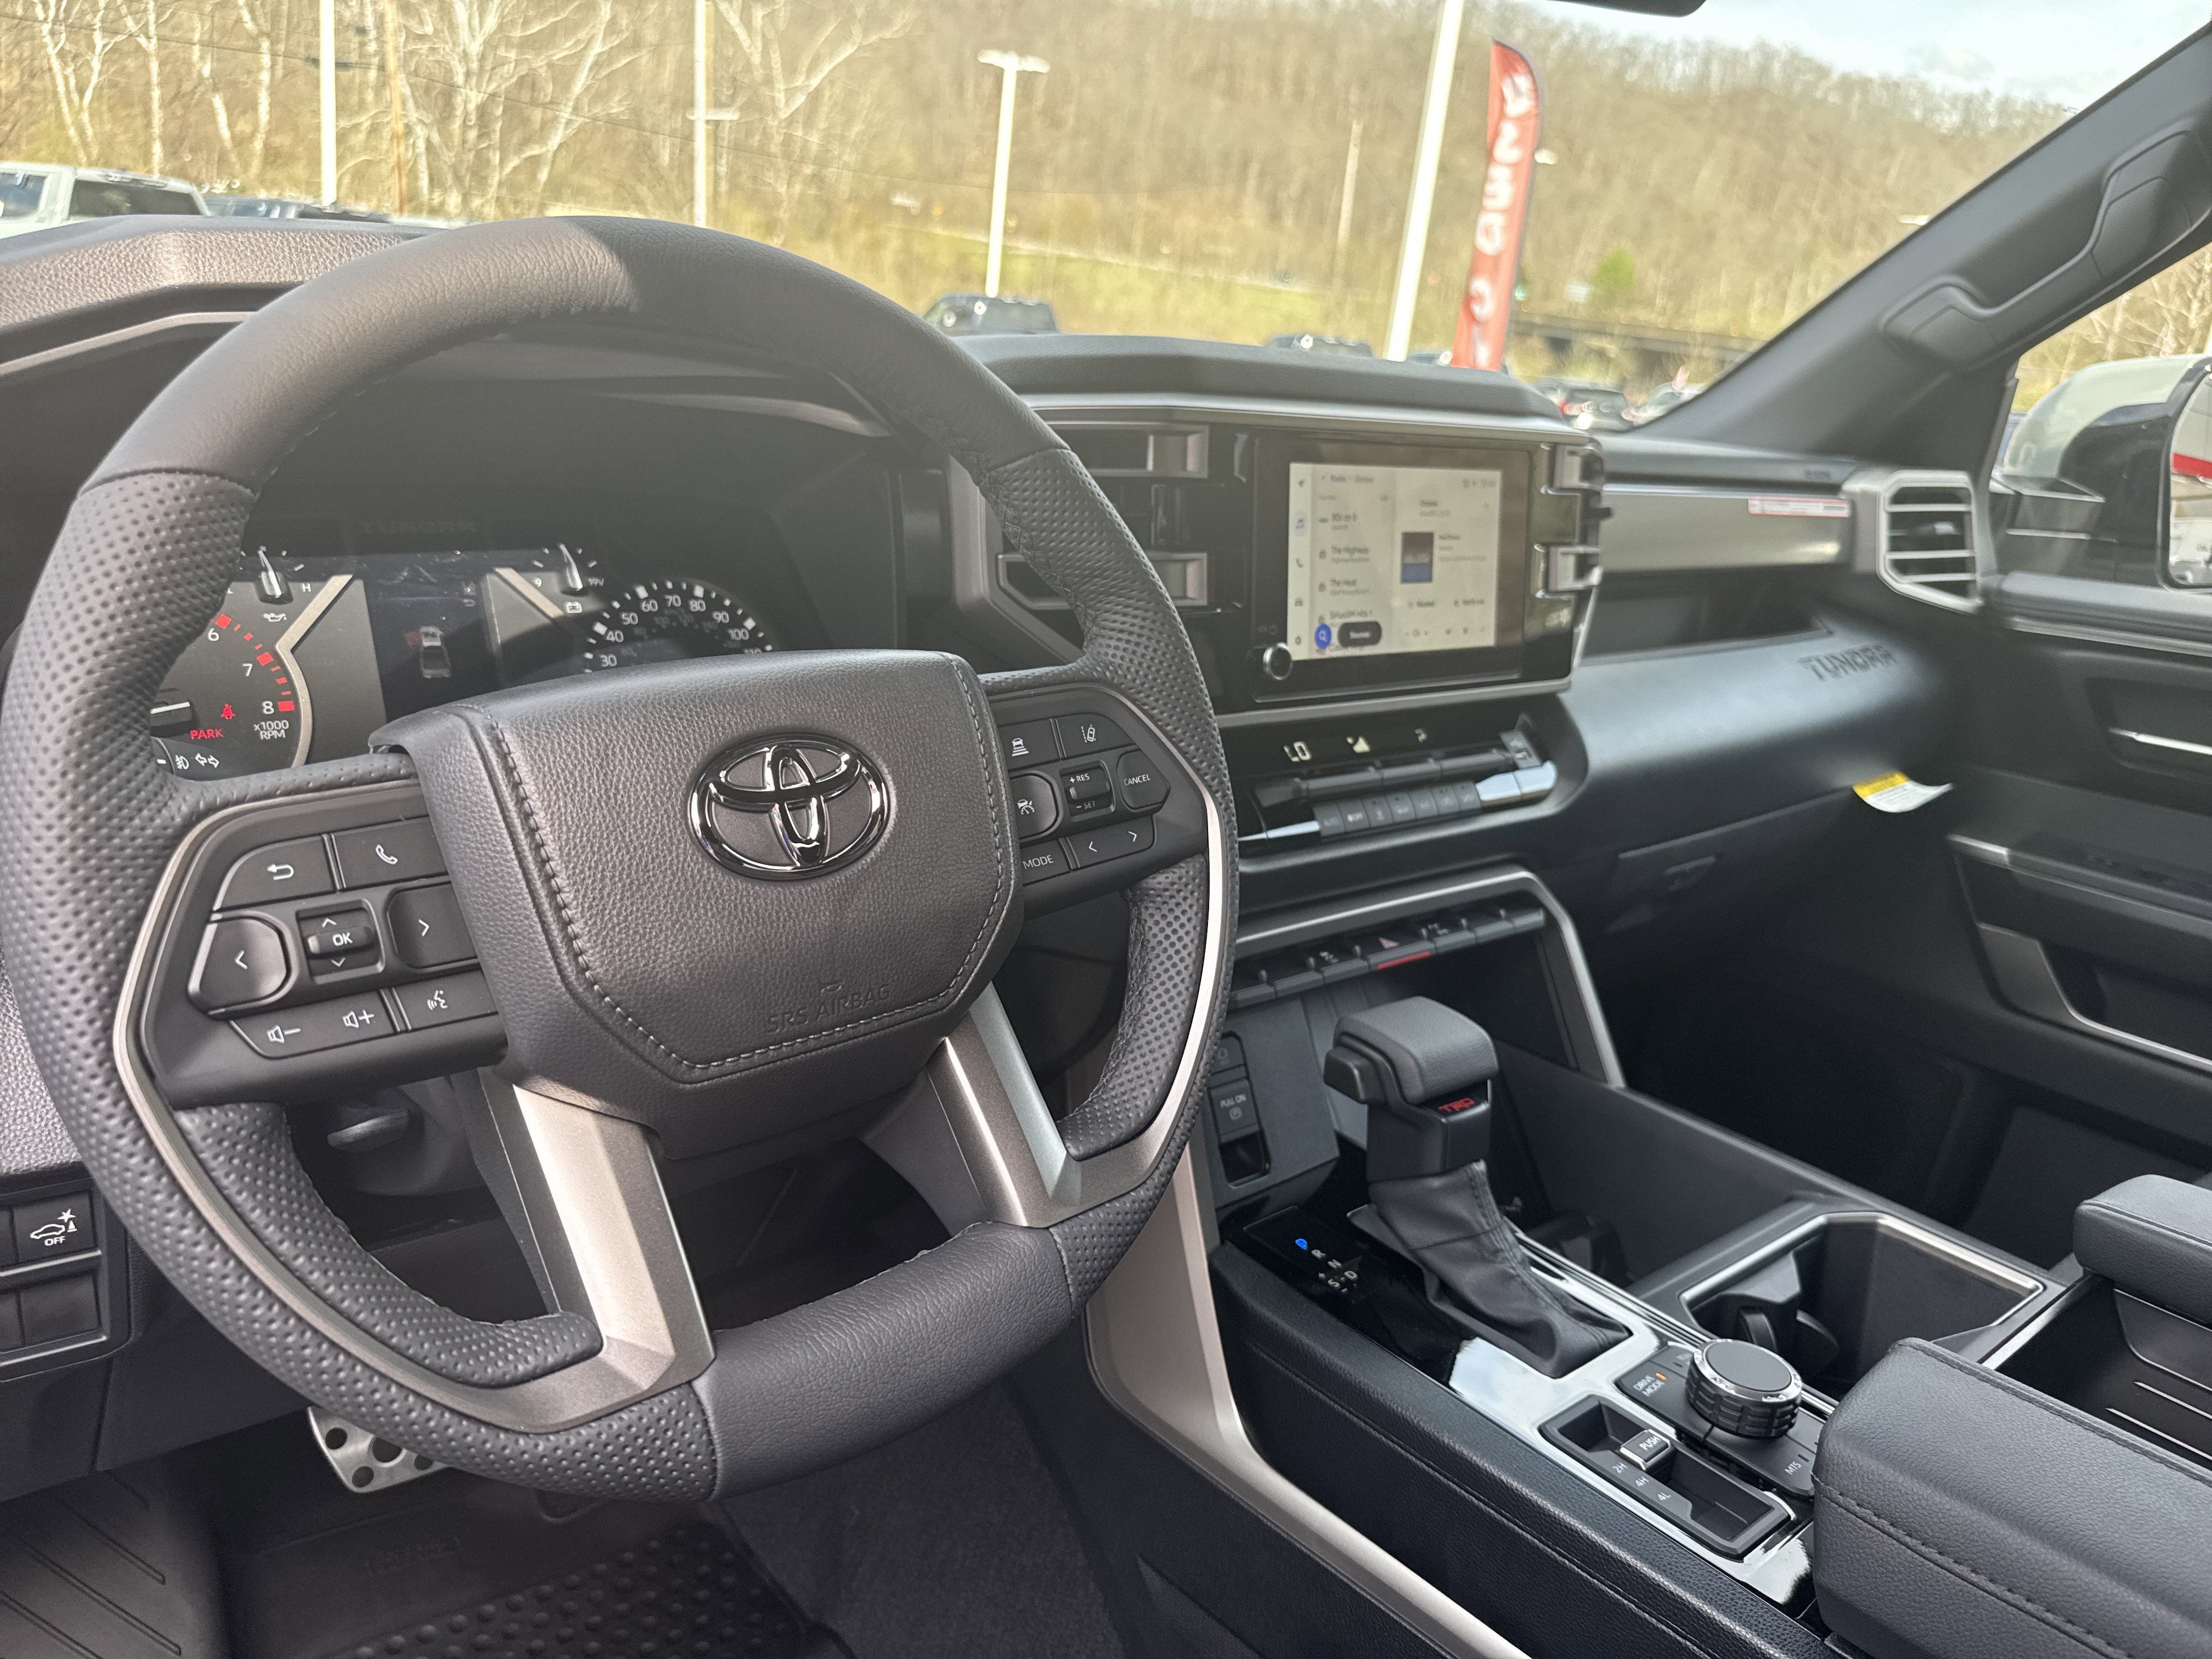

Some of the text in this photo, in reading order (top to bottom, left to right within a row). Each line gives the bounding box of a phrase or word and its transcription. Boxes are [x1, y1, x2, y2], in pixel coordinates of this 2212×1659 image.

[302, 583, 312, 592] H
[641, 599, 659, 612] 60
[664, 594, 681, 607] 70
[689, 599, 707, 612] 80
[620, 612, 639, 625] 50
[713, 611, 730, 624] 90
[207, 628, 219, 641] 6
[606, 630, 624, 643] 40
[728, 628, 749, 641] 100
[601, 654, 618, 667] 30
[1797, 644, 1898, 682] TUNDRA
[242, 663, 252, 677] 7
[262, 700, 274, 715] 8
[254, 720, 289, 732] x1000
[190, 729, 223, 740] PARK
[260, 730, 286, 740] RPM
[1284, 741, 1312, 762] LO
[1124, 774, 1151, 786] CANCEL
[1023, 854, 1054, 870] MODE
[332, 932, 353, 946] OK
[768, 983, 893, 1034] SRS AIRBAG
[1220, 1093, 1247, 1109] PULL ON
[1438, 1097, 1475, 1114] TRD
[44, 1235, 66, 1246] OFF
[1311, 1249, 1327, 1259] R
[1328, 1259, 1342, 1269] N
[1344, 1270, 1358, 1280] D
[1328, 1279, 1340, 1289] S
[1633, 1375, 1655, 1391] DRIVE
[1642, 1379, 1665, 1397] MODE
[1639, 1435, 1662, 1451] PUSH
[1612, 1462, 1628, 1474] 2H
[1784, 1460, 1802, 1475] MTS
[1635, 1476, 1649, 1486] 4H
[1657, 1492, 1672, 1500] 4L
